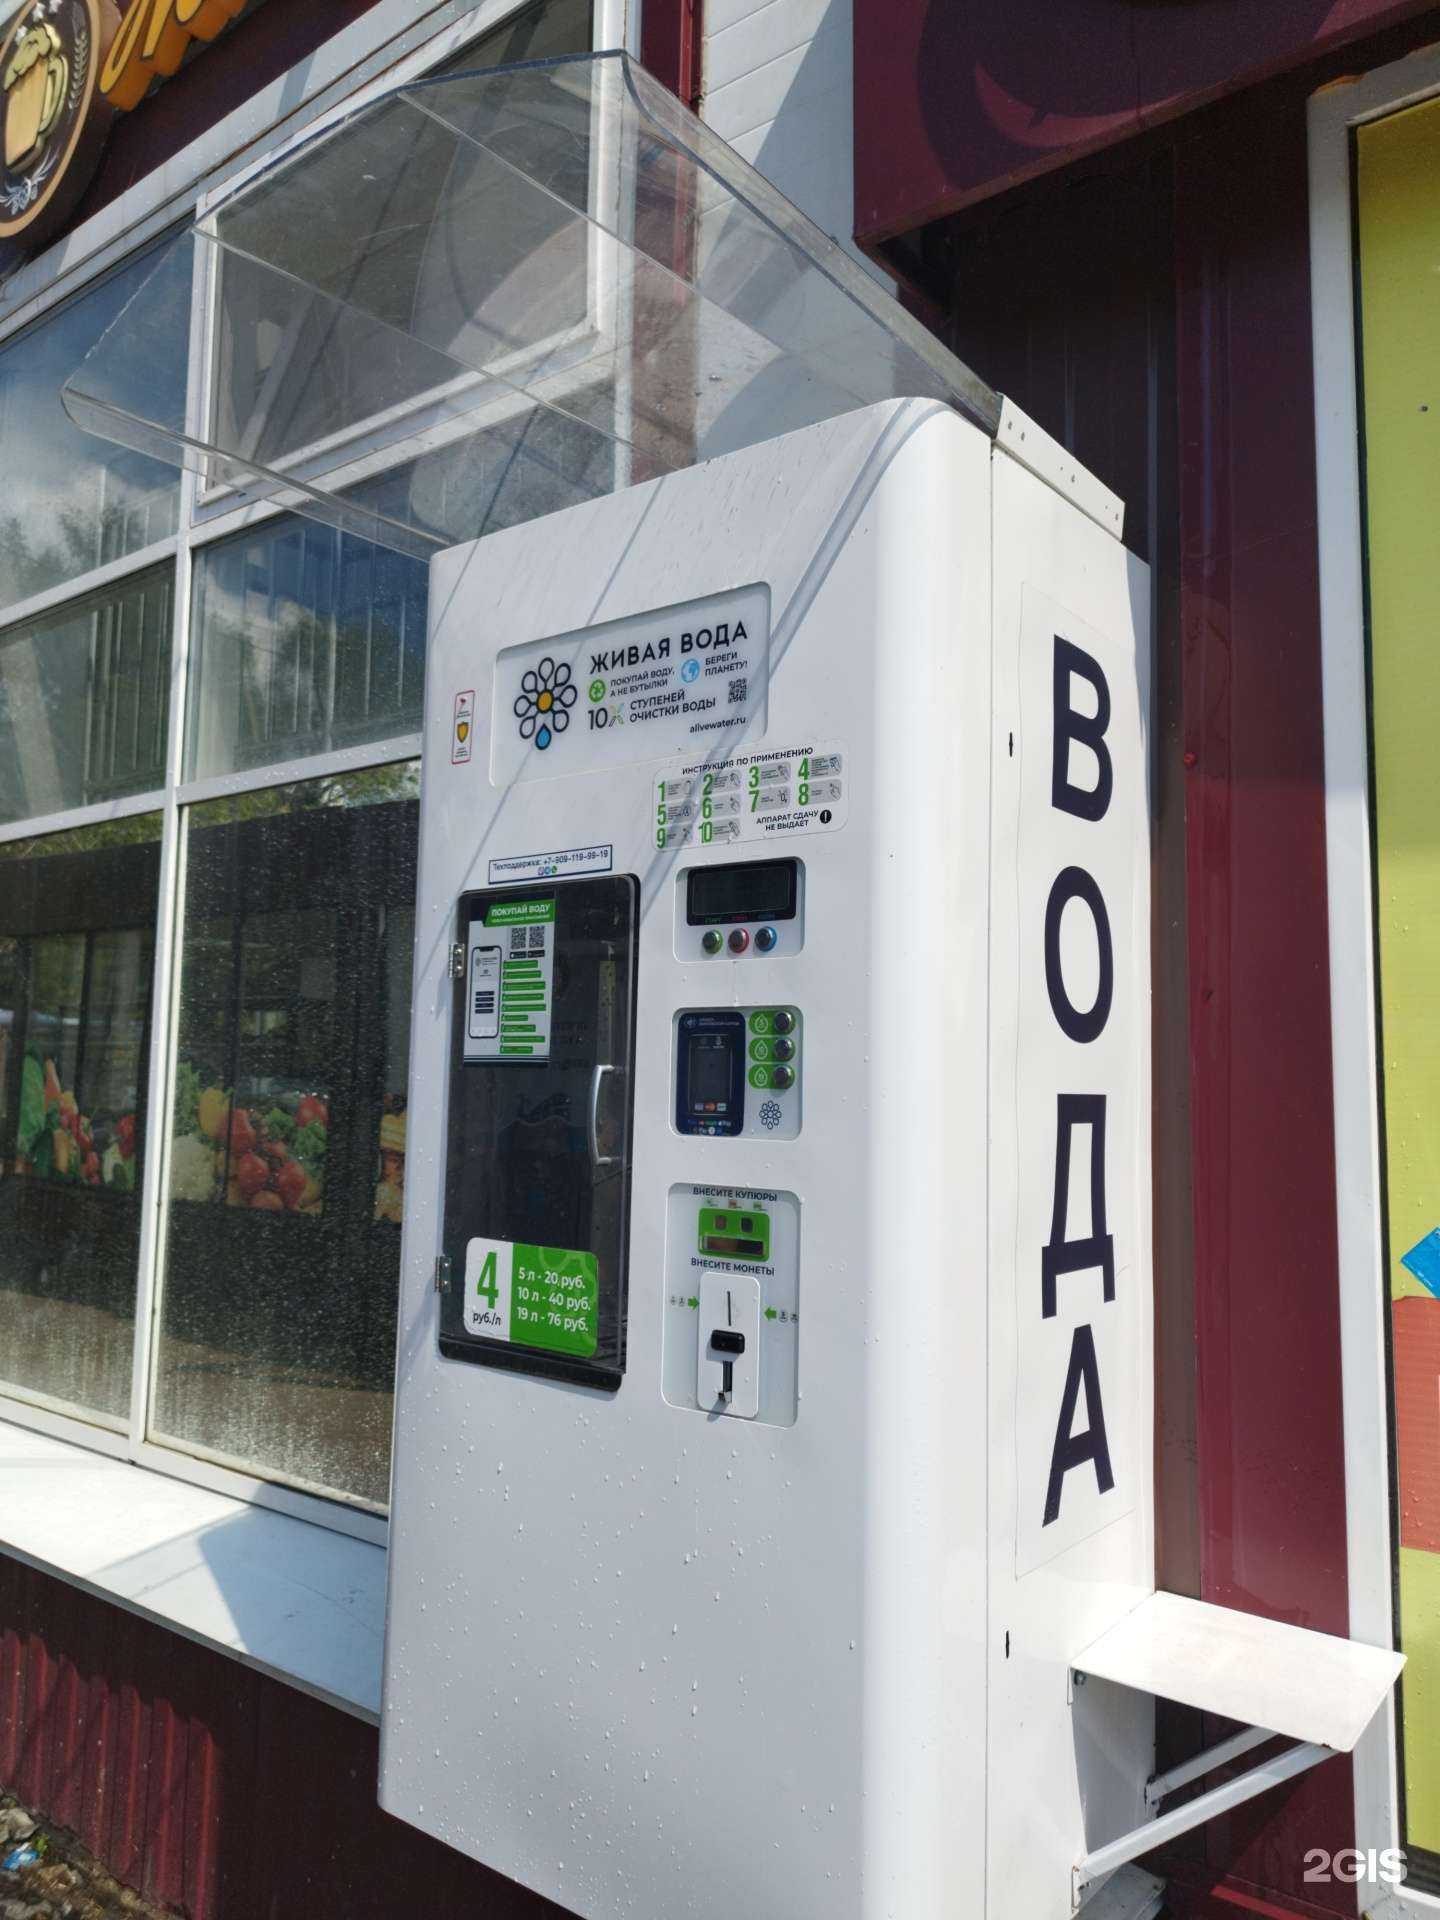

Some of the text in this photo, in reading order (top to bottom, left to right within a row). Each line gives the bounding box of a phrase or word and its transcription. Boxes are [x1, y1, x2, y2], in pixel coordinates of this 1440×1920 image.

[590, 620, 748, 675] ЖИВАЯ ВОДА
[705, 651, 738, 665] БЕРЕГИ
[610, 666, 675, 687] ПОКУПАЙ ВОДУ,
[705, 660, 748, 677] ПЛАНЕТУ!
[617, 687, 628, 695] НЕ
[630, 679, 668, 693] БУТЫЛКИ
[631, 688, 685, 710] СТУПЕНЕЙ
[587, 707, 608, 730] 10
[629, 697, 717, 723] ОЧИСТКИ ВОДЫ
[689, 716, 747, 734] alivewater.ru
[682, 747, 814, 775] ИНСТРУКЦИЯ ПО ПРИМЕНЕНИЮ
[798, 758, 810, 780] 4
[703, 774, 713, 795] 2
[749, 766, 760, 788] 3
[657, 781, 666, 802] 1
[748, 790, 760, 812] 7
[798, 783, 809, 805] 8
[657, 804, 666, 825] 5
[702, 797, 712, 818] 6
[756, 809, 819, 825] АППАРАТ СДАЧУ
[698, 821, 713, 843] 10
[765, 823, 776, 831] НЕ
[657, 828, 666, 849] 9
[491, 905, 528, 916] ПОКУПАЙ
[1042, 634, 1116, 1528] ВОДА
[692, 1186, 778, 1202] ВНЕСИТЕ КУПЮРЫ
[691, 1257, 775, 1276] ВНЕСИТЕ МОНЕТЫ
[476, 1251, 500, 1309] 4
[518, 1267, 526, 1280] 5
[544, 1271, 559, 1285] 20
[561, 1276, 586, 1290] руб.
[517, 1287, 530, 1300] 10
[531, 1290, 540, 1302] л
[548, 1292, 564, 1306] 40
[566, 1297, 591, 1311] руб.
[472, 1311, 502, 1327] руб./л
[517, 1306, 529, 1321] 19
[530, 1310, 539, 1322] л
[547, 1312, 562, 1326] 76
[563, 1317, 589, 1332] руб.
